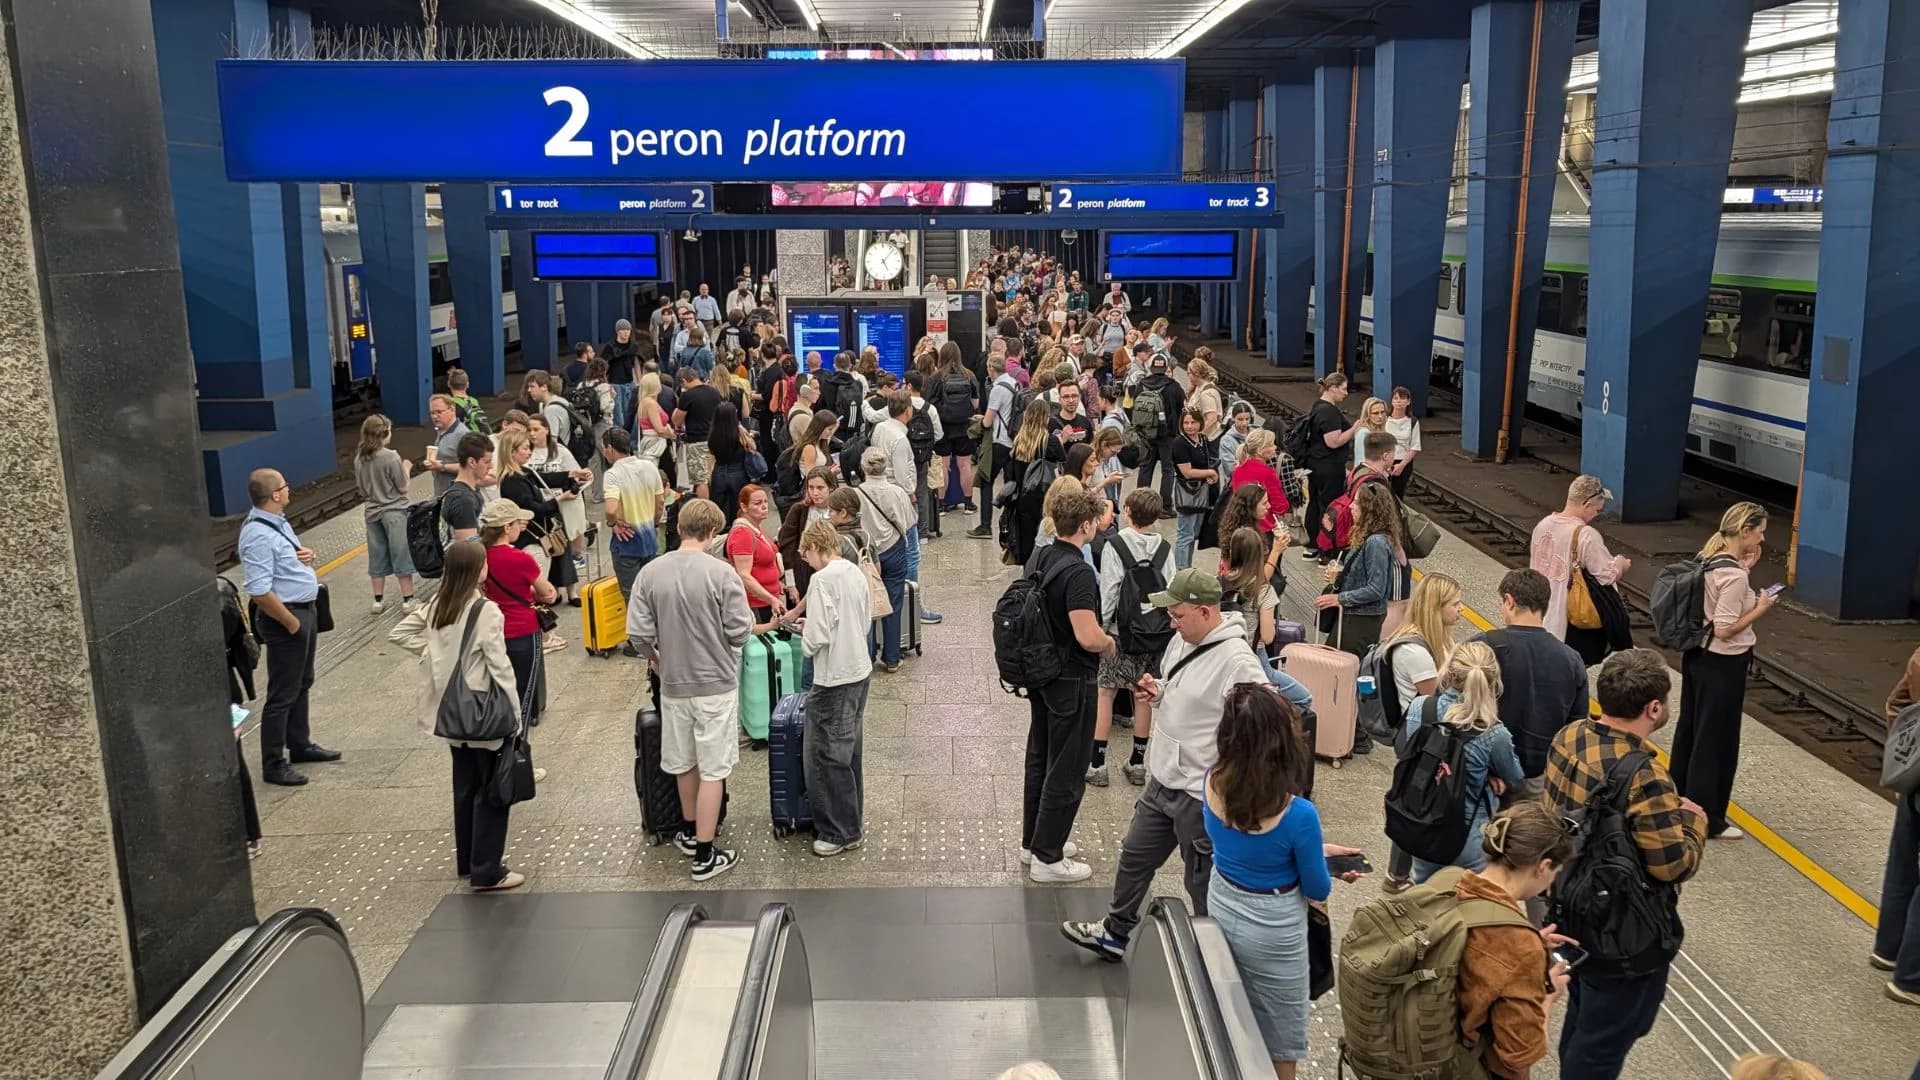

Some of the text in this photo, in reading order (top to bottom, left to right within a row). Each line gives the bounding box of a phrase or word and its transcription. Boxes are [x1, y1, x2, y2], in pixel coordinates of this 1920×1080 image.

[542, 86, 906, 165] 2 peron platform
[500, 188, 559, 209] 1 tor track
[619, 189, 706, 211] peron platform 2
[1058, 188, 1146, 211] 2 peron platform
[1208, 187, 1270, 208] tor track 3
